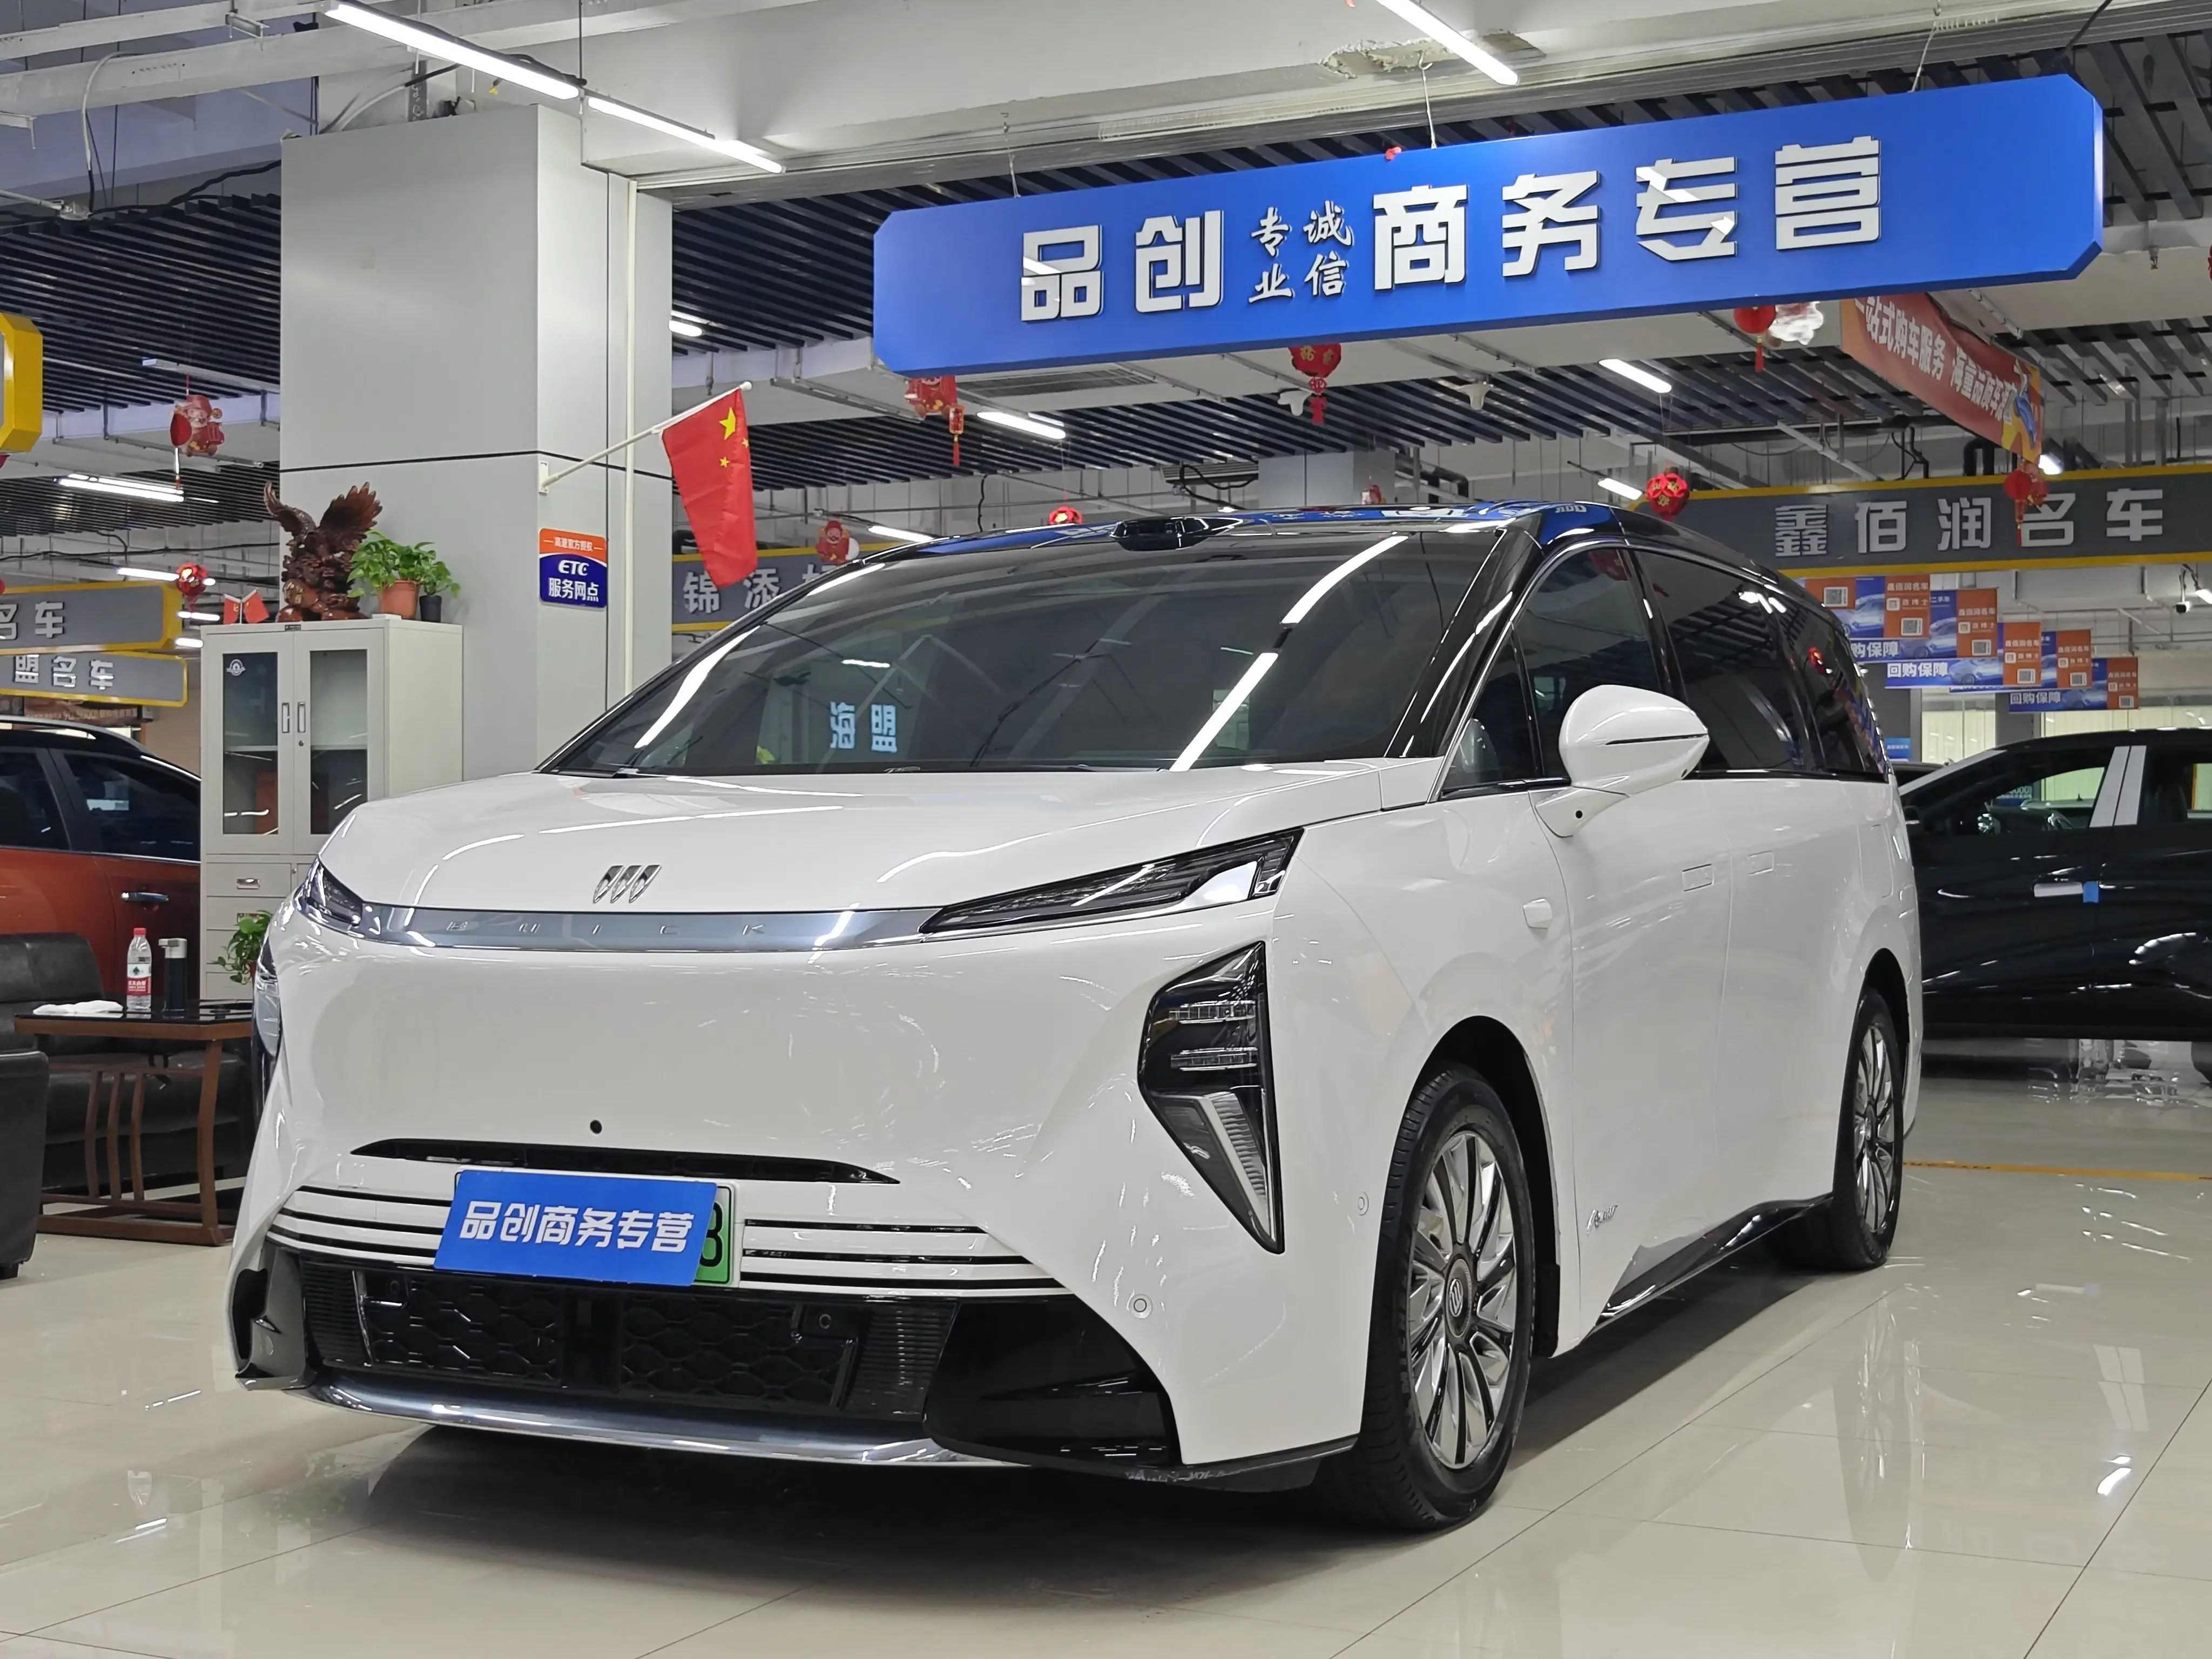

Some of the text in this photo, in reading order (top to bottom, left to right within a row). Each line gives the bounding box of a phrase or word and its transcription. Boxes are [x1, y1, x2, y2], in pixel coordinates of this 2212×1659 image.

[1021, 135, 1881, 322] 品创 商务专营
[1304, 200, 1354, 297] 诚信
[1248, 206, 1294, 304] 专业
[1775, 488, 2163, 558] 鑫佰润名车
[549, 577, 599, 602] 服务网点
[558, 559, 590, 576] ETC
[15, 654, 114, 690] 盟名车
[1887, 662, 1948, 678] 回购保障
[2010, 692, 2061, 704] 回购保障
[459, 1200, 694, 1253] 品创商务专营
